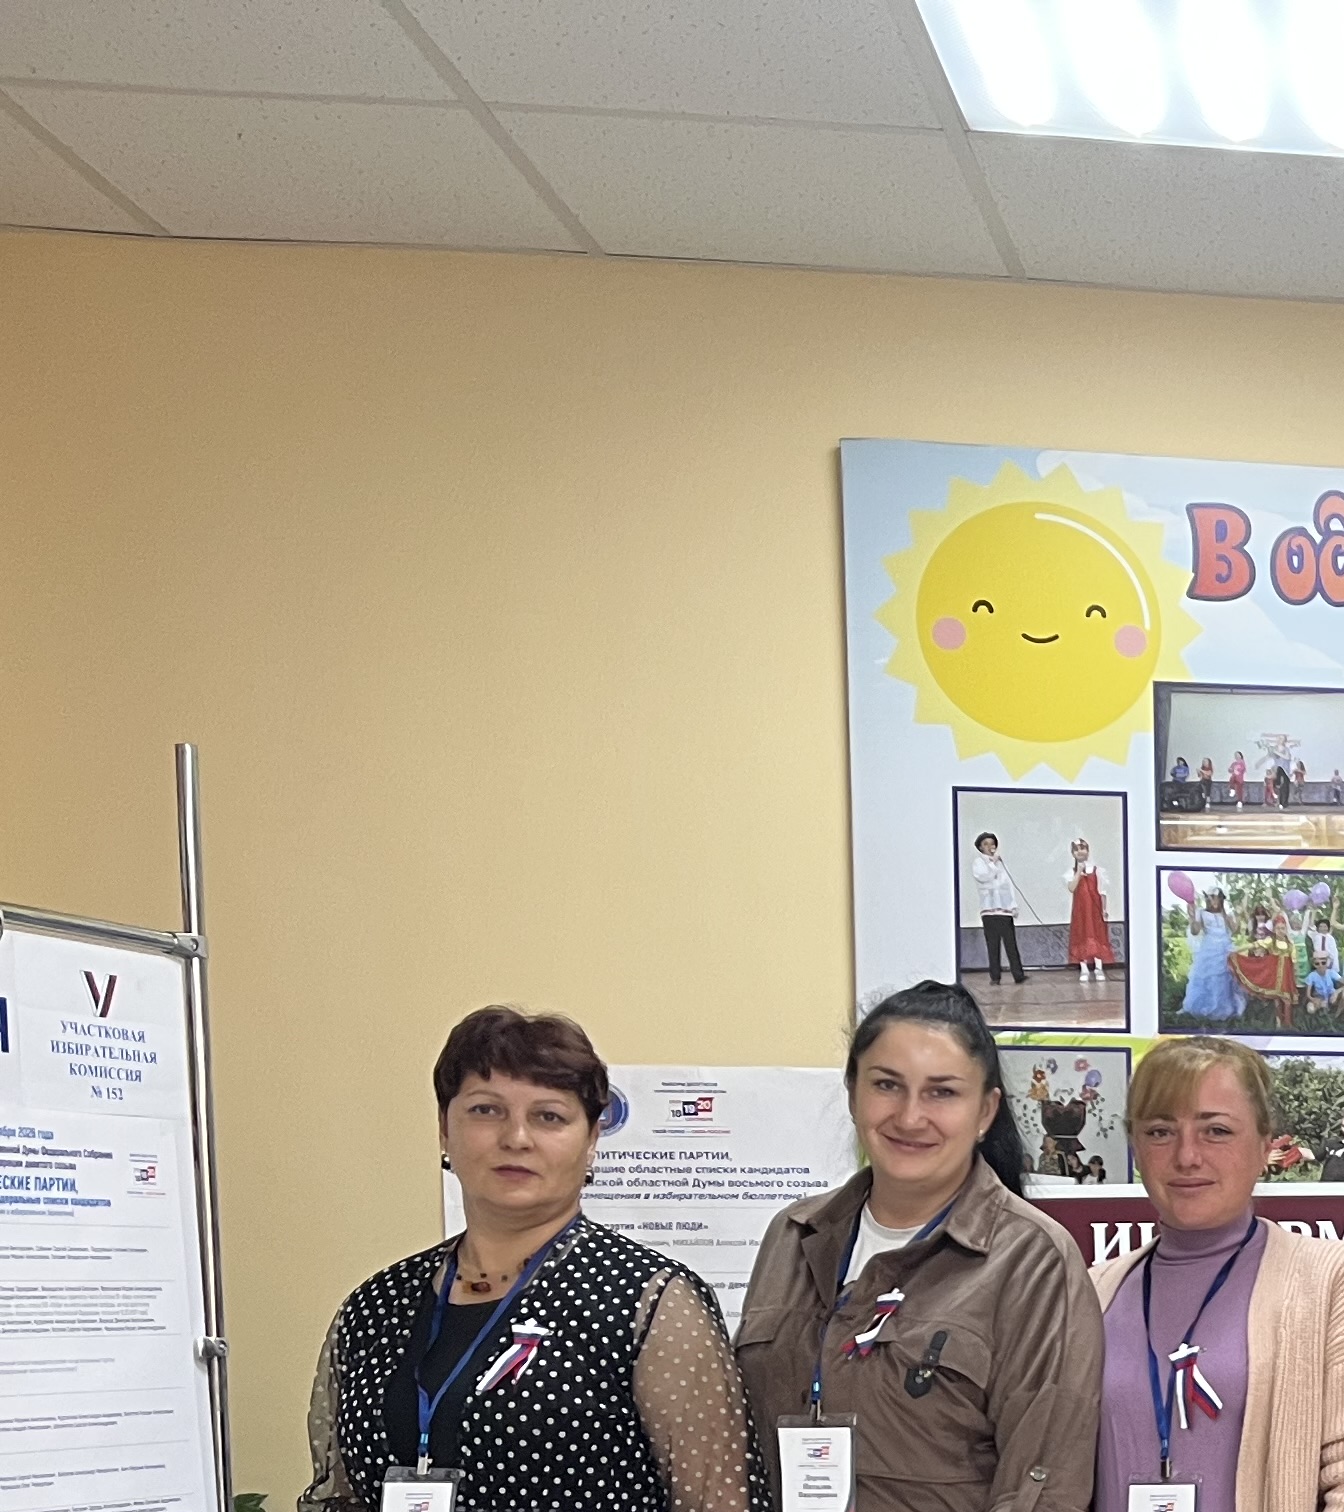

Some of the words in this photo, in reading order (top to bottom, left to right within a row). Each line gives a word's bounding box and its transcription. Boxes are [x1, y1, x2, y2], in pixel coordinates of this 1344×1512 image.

[1186, 503, 1255, 602] В
[60, 1020, 146, 1043] УЧАСТКОВАЯ
[50, 1040, 157, 1064] ИЗБИРАТЕЛЬНАЯ
[69, 1063, 142, 1083] КОМИССИЯ
[697, 1100, 711, 1110] 20
[679, 1151, 732, 1161] ПАРТИИ,
[628, 1164, 692, 1174] областные
[740, 1167, 810, 1175] кандидатов
[626, 1178, 689, 1188] областной
[692, 1178, 725, 1189] Думы
[728, 1180, 783, 1188] восьмого
[786, 1180, 829, 1188] созыва
